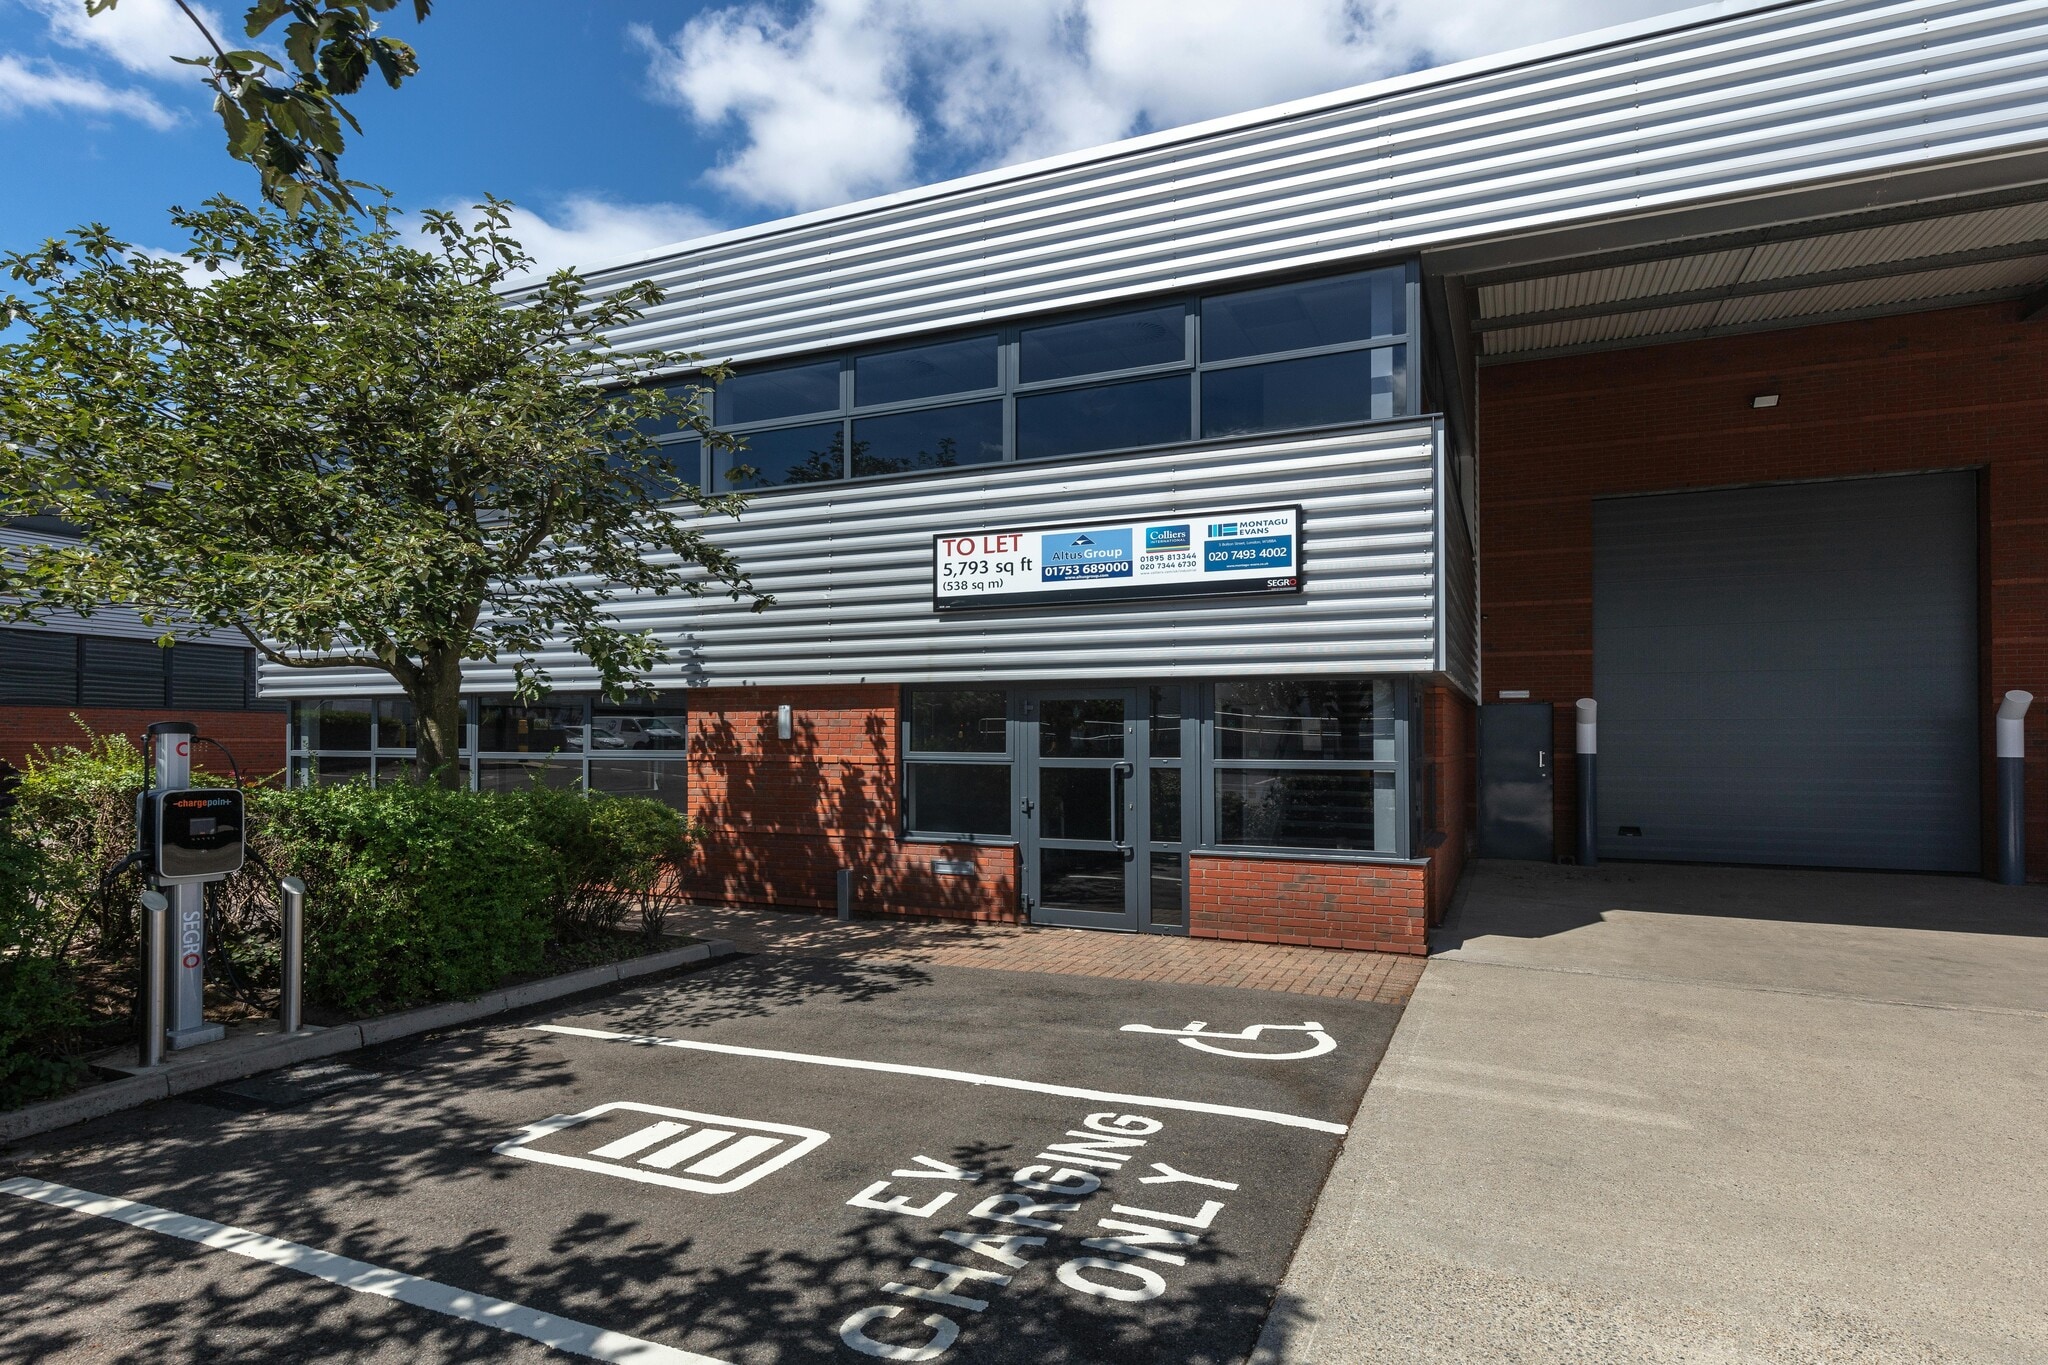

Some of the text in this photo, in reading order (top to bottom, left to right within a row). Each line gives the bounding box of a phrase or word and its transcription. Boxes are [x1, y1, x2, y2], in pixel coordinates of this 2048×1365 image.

[1239, 518, 1288, 528] MONTAGU
[1149, 530, 1186, 540] Colliers
[1239, 527, 1269, 536] EVANS
[942, 534, 1023, 557] TO LET
[1140, 552, 1197, 563] 01895 813344
[1208, 547, 1287, 562] 020 7493 4002
[943, 557, 1033, 578] 5,793 sq ft
[1045, 562, 1129, 577] 01753 689000
[1140, 563, 1155, 571] 020
[1177, 560, 1197, 568] 6730
[942, 578, 1004, 591] (538 sq m)
[1267, 578, 1297, 587] SEGRO
[182, 911, 201, 969] SEGRO
[845, 1154, 984, 1218] EV
[839, 1111, 1164, 1362] CHARGING
[1055, 1162, 1240, 1302] ONLY
